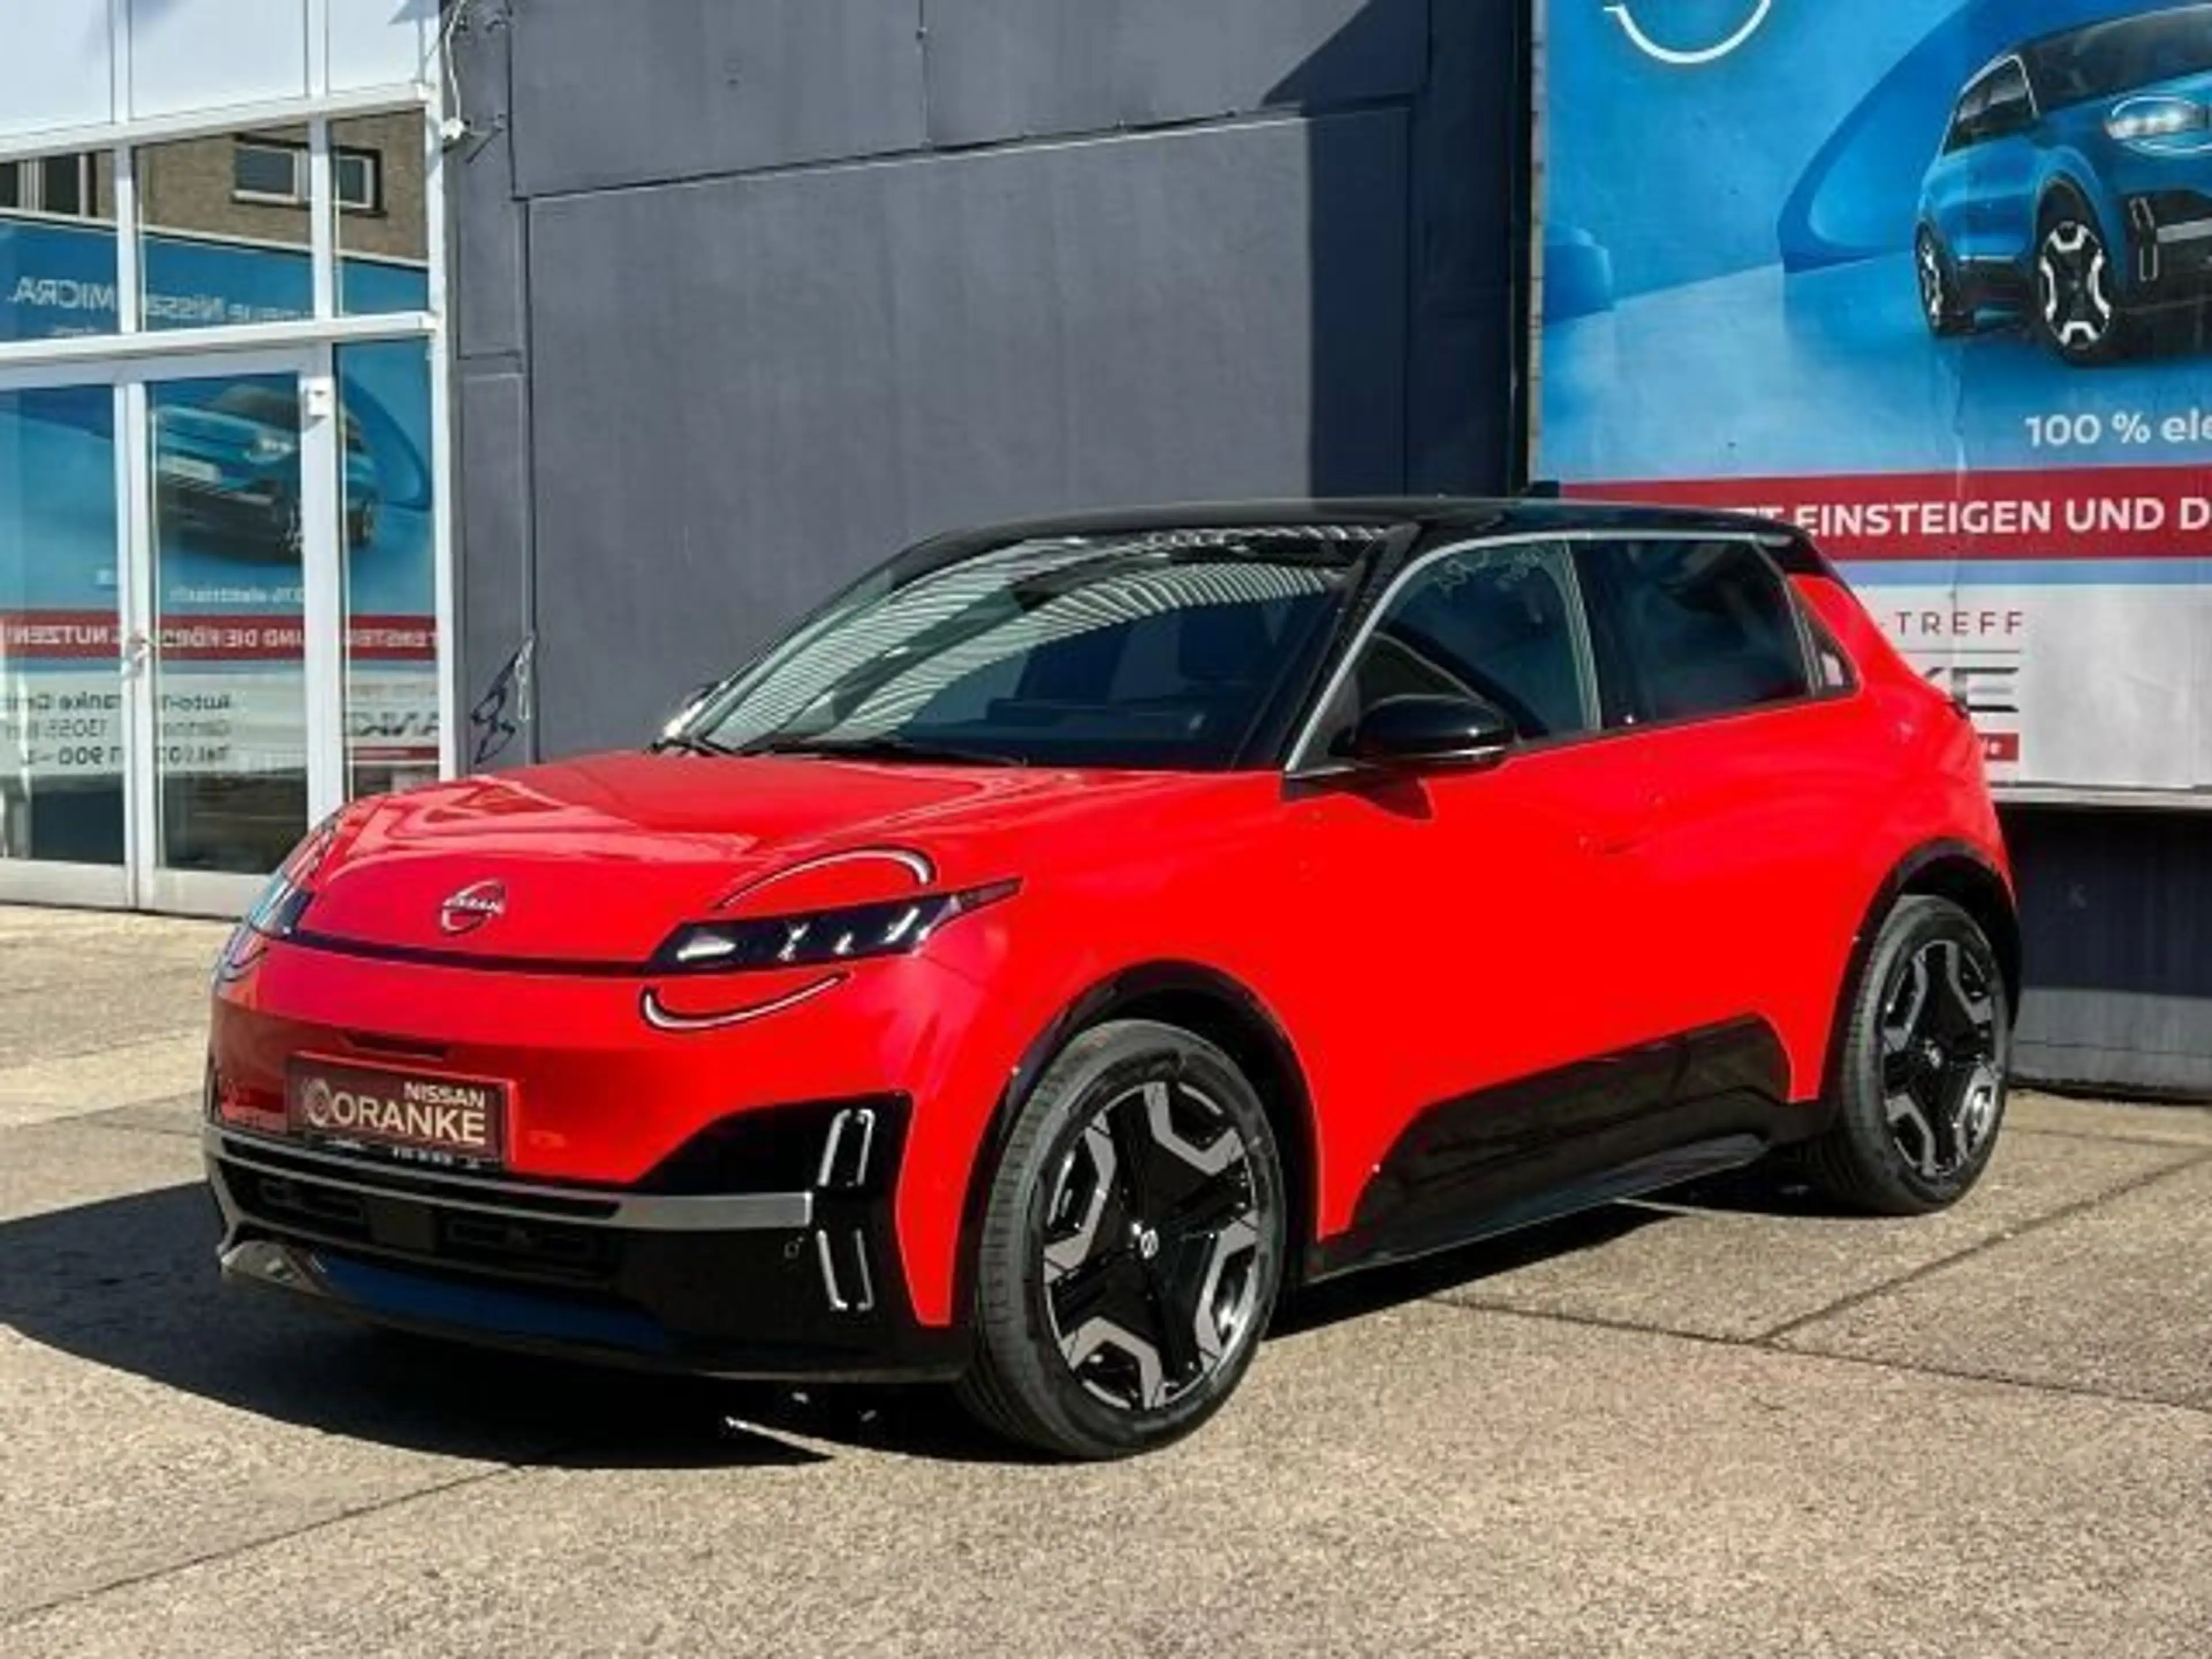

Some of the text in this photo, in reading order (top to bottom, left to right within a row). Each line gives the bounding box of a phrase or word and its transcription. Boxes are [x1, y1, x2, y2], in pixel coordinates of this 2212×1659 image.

[2024, 413, 2101, 449] 100
[2111, 409, 2152, 444] %
[1794, 499, 2051, 537] EINSTEIGEN
[2066, 497, 2165, 533] UND
[404, 1081, 486, 1109] NISSAN
[332, 1091, 486, 1146] ORANKE
